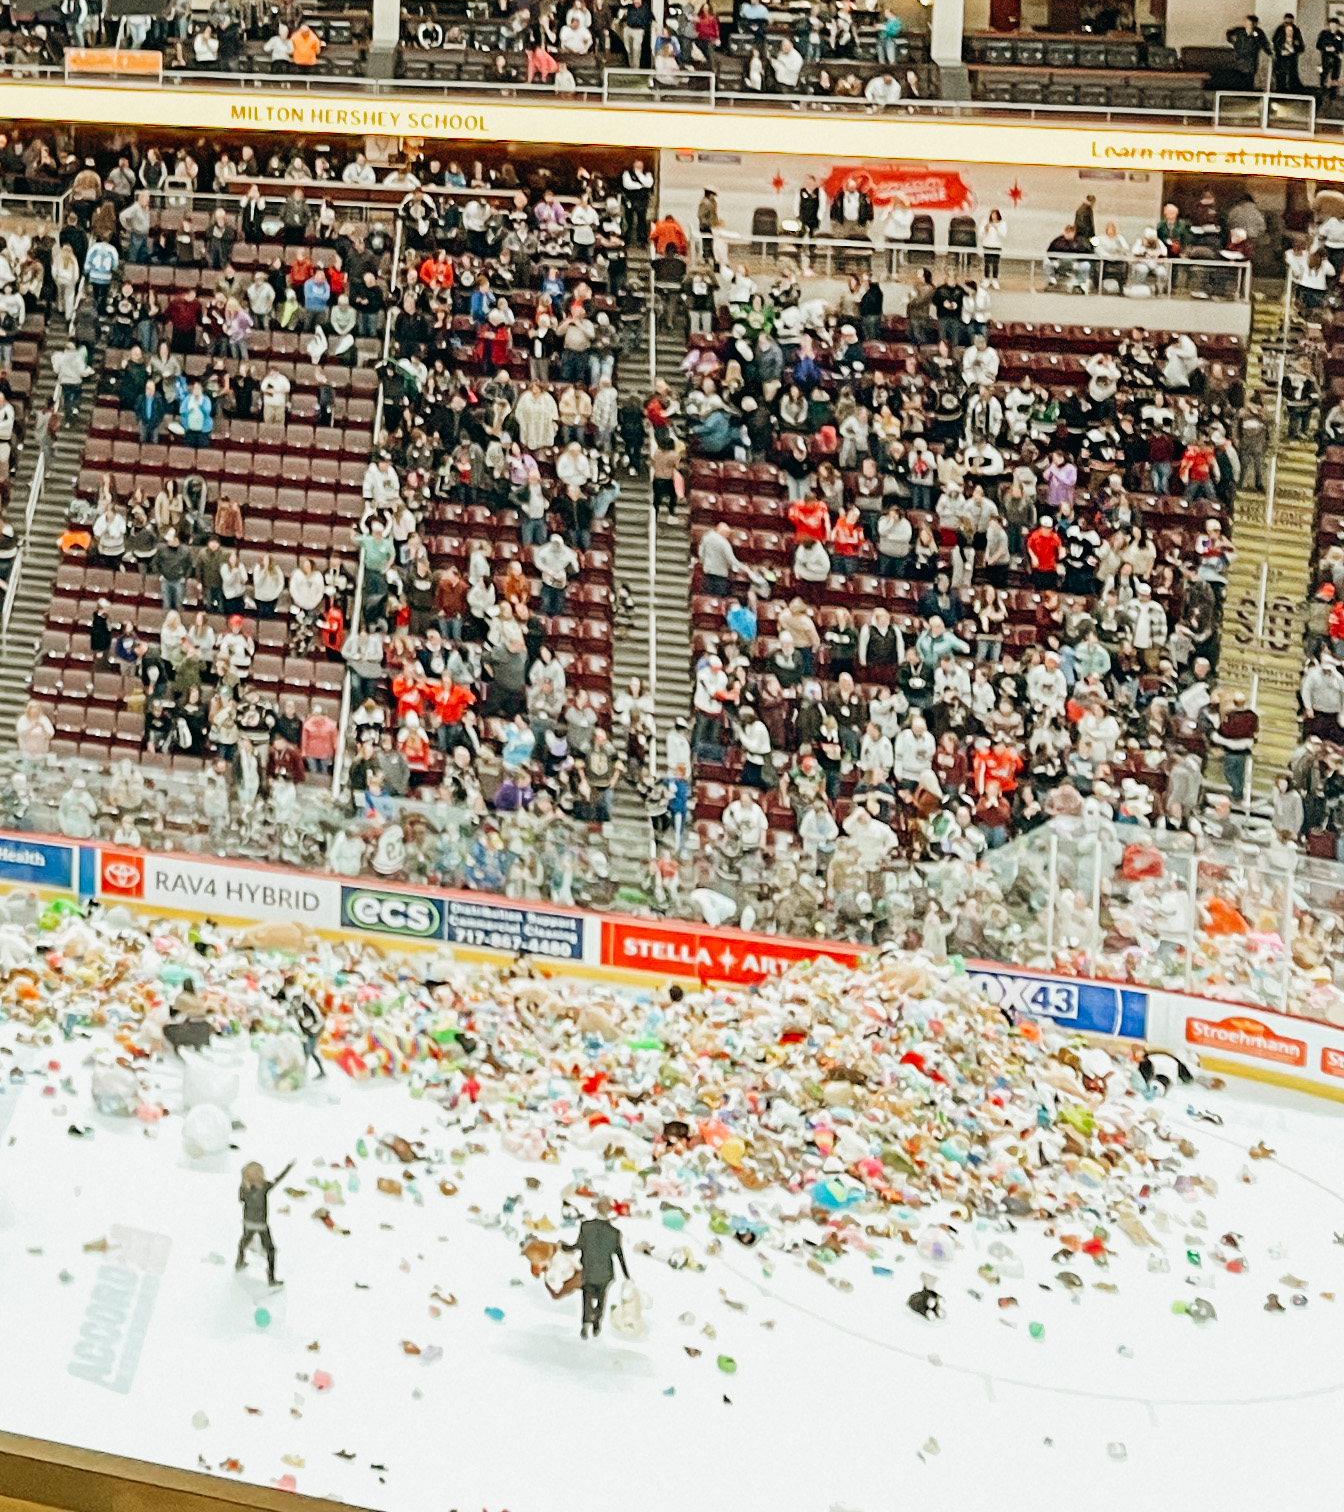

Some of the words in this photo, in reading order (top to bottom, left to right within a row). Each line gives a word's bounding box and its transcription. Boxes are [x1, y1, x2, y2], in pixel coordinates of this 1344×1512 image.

[231, 104, 304, 123] MILTON
[311, 108, 401, 127] HERSHEY
[407, 112, 489, 132] SCHOOL
[1091, 141, 1153, 159] Learn
[1161, 148, 1218, 163] more
[1224, 148, 1246, 164] at
[155, 871, 216, 897] RAV4
[227, 875, 321, 913] HYBRID
[354, 896, 430, 931] ecs
[623, 937, 712, 966] STELLA
[742, 953, 792, 975] ART
[1193, 1023, 1302, 1058] Stroehmann
